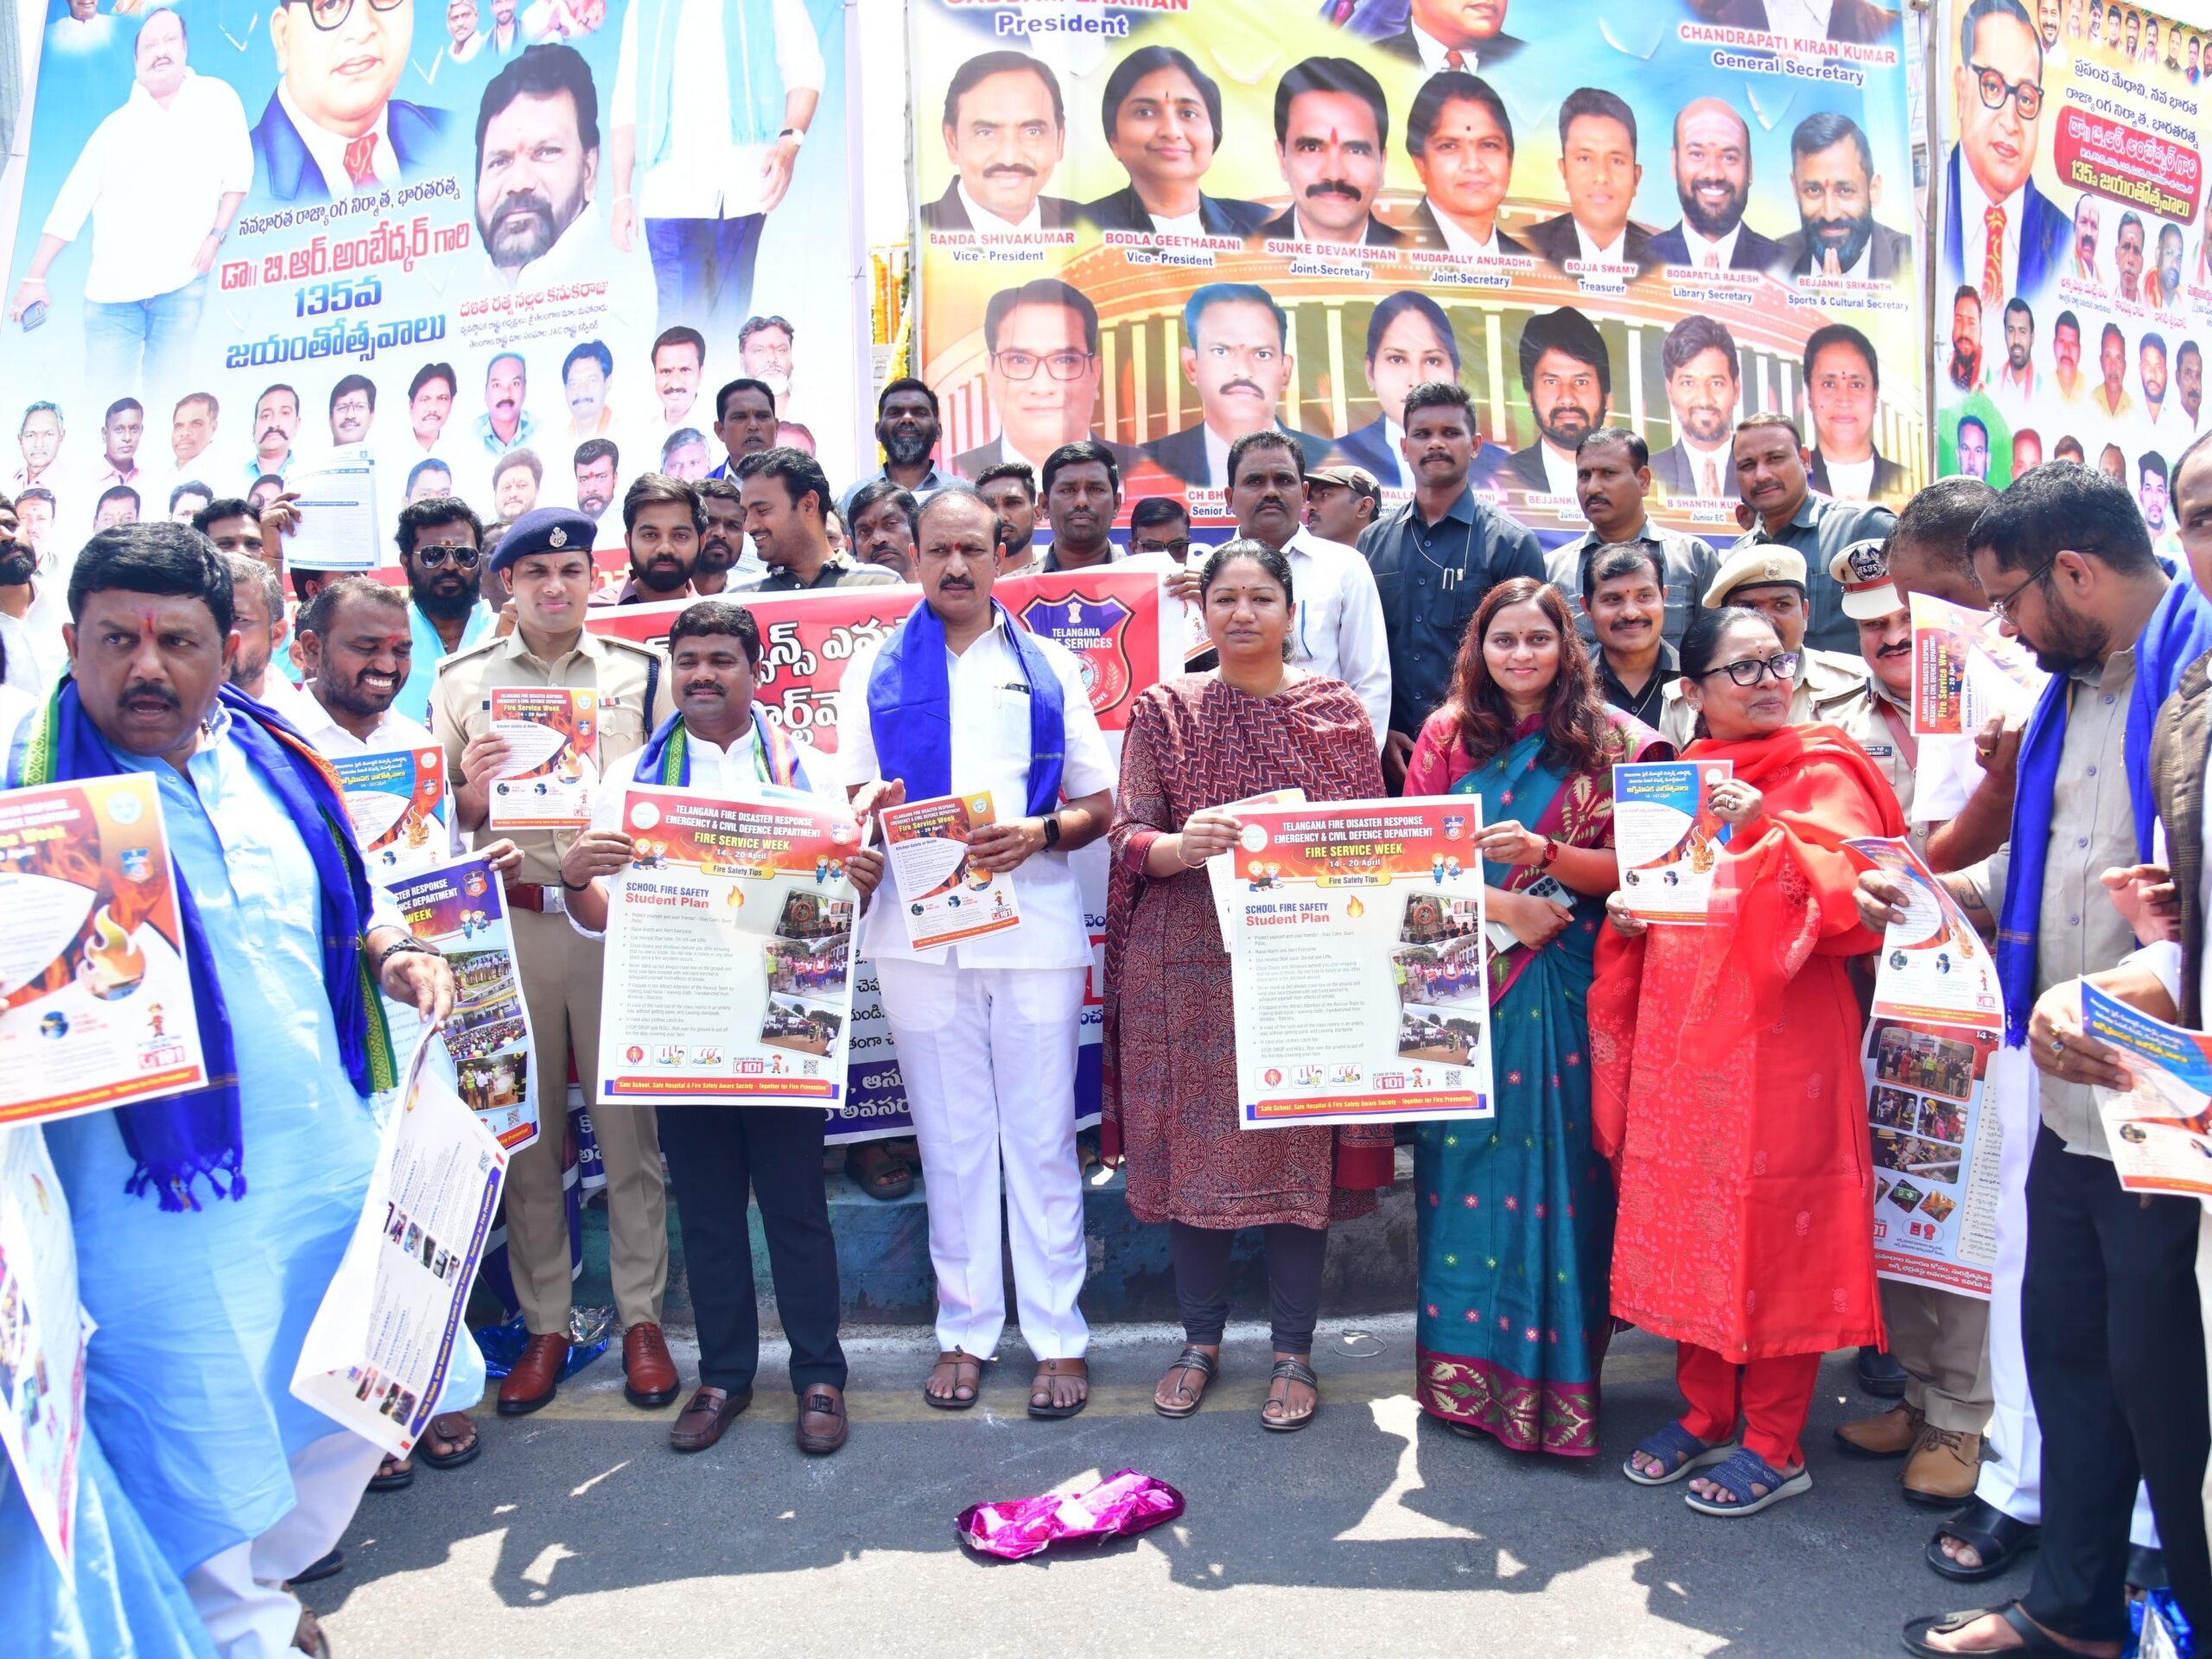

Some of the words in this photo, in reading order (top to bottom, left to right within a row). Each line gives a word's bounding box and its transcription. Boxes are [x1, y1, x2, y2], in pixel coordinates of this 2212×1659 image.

[999, 15, 1126, 35] President
[1681, 25, 1789, 50] CHANDRAPATI
[1794, 38, 1839, 56] KIRAN
[1844, 44, 1896, 64] KUMAR
[1713, 52, 1779, 72] General
[1786, 60, 1864, 86] Secretary
[238, 210, 293, 236] నవభారత
[397, 176, 461, 207] భారతరత్న
[434, 223, 470, 253] గారి
[930, 232, 976, 245] BANDA
[981, 232, 1075, 245] SHIVAKUMAR
[1105, 232, 1151, 245] BODLA
[1155, 235, 1241, 251] GEETHARANI
[953, 251, 978, 262] Vice
[989, 250, 1044, 262] President
[1127, 251, 1151, 264] Vice
[1160, 253, 1213, 266] President
[1268, 242, 1313, 254] SUNKE
[1316, 245, 1396, 260] DEVAKISHAN
[1412, 252, 1473, 264] MUDAPALLY
[1476, 256, 1533, 268] ANURADHA
[1291, 264, 1370, 279] Joint-Secretary
[1567, 262, 1599, 272] BOJJA
[1601, 264, 1637, 276] SWAMY
[1667, 269, 1720, 281] BODAPATLA
[1723, 271, 1759, 283] RAJESH
[1432, 272, 1510, 287] Joint-Secretary
[1799, 278, 1844, 289] BEJJANKI
[1846, 280, 1891, 291] SRIKANTH
[1580, 281, 1625, 294] Treasurer
[294, 274, 382, 317] 135వ
[1673, 287, 1706, 301] Library
[1708, 289, 1753, 304] Secretary
[1789, 294, 1818, 308] Sports
[1821, 296, 1827, 306] &
[1829, 296, 1865, 308] Cultural
[1866, 298, 1910, 311] Secretary
[549, 327, 563, 336] JAC
[226, 314, 447, 369] జయంతోత్సవాలు
[1188, 491, 1205, 500] CH
[1529, 495, 1576, 505] BEJJANKI
[1192, 505, 1223, 516] Senior
[1667, 499, 1674, 508] B
[1676, 499, 1718, 509] SHANTHI
[1560, 512, 1582, 520] Junior
[1692, 513, 1713, 522] Junior
[1052, 627, 1101, 638] TELANGANA
[1064, 638, 1113, 649] SERVICES
[1937, 645, 1947, 666] Week
[1938, 668, 1948, 699] Service
[1949, 677, 1955, 685] 20
[1091, 691, 1109, 707] SAVE
[1938, 701, 1947, 717] Fire
[676, 804, 719, 818] TELANGANA
[721, 808, 736, 820] FIRE
[739, 810, 773, 823] DISASTER
[775, 814, 813, 826] RESPONSE
[912, 819, 937, 830] Service
[938, 815, 955, 823] Week
[666, 815, 710, 829] EMERGENCY
[712, 820, 717, 830] &
[719, 821, 737, 832] CIVIL
[740, 824, 772, 835] DEFENCE
[773, 826, 821, 838] DEPARTMENT
[1283, 819, 1326, 831] TELANGANA
[1328, 819, 1344, 830] FIRE
[1346, 817, 1382, 829] DISASTER
[1384, 816, 1423, 826] RESPONSE
[695, 832, 716, 845] FIRE
[719, 835, 760, 849] SERVICE
[763, 839, 790, 851] WEEK
[1274, 831, 1319, 844] EMERGENCY
[1321, 831, 1326, 842] &
[1329, 830, 1347, 842] CIVIL
[1349, 829, 1382, 840] DEFENCE
[1384, 827, 1433, 839] DEPARTMENT
[734, 849, 745, 858] 20
[747, 851, 766, 860] April
[1306, 847, 1327, 858] FIRE
[1330, 845, 1371, 857] SERVICE
[1375, 843, 1403, 855] WEEK
[1362, 858, 1380, 868] April
[728, 867, 747, 876] Safety
[411, 879, 448, 896] RESPONSE
[1328, 876, 1341, 885] Fire
[1343, 875, 1363, 886] Safety
[1364, 875, 1378, 884] Tips
[412, 887, 458, 907] DEPARTMENT
[626, 882, 658, 893] SCHOOL
[660, 886, 678, 894] FIRE
[680, 887, 709, 897] SAFETY
[626, 893, 677, 906] Student
[681, 897, 709, 908] Plan
[1245, 904, 1277, 914] SCHOOL
[1279, 903, 1297, 912] FIRE
[1300, 902, 1328, 912] SAFETY
[405, 908, 432, 924] WEEK
[1246, 914, 1297, 926] Student
[1301, 912, 1330, 924] Plan
[1977, 1031, 1986, 1039] 14
[743, 1063, 762, 1072] 101
[1384, 1077, 1403, 1088] 101
